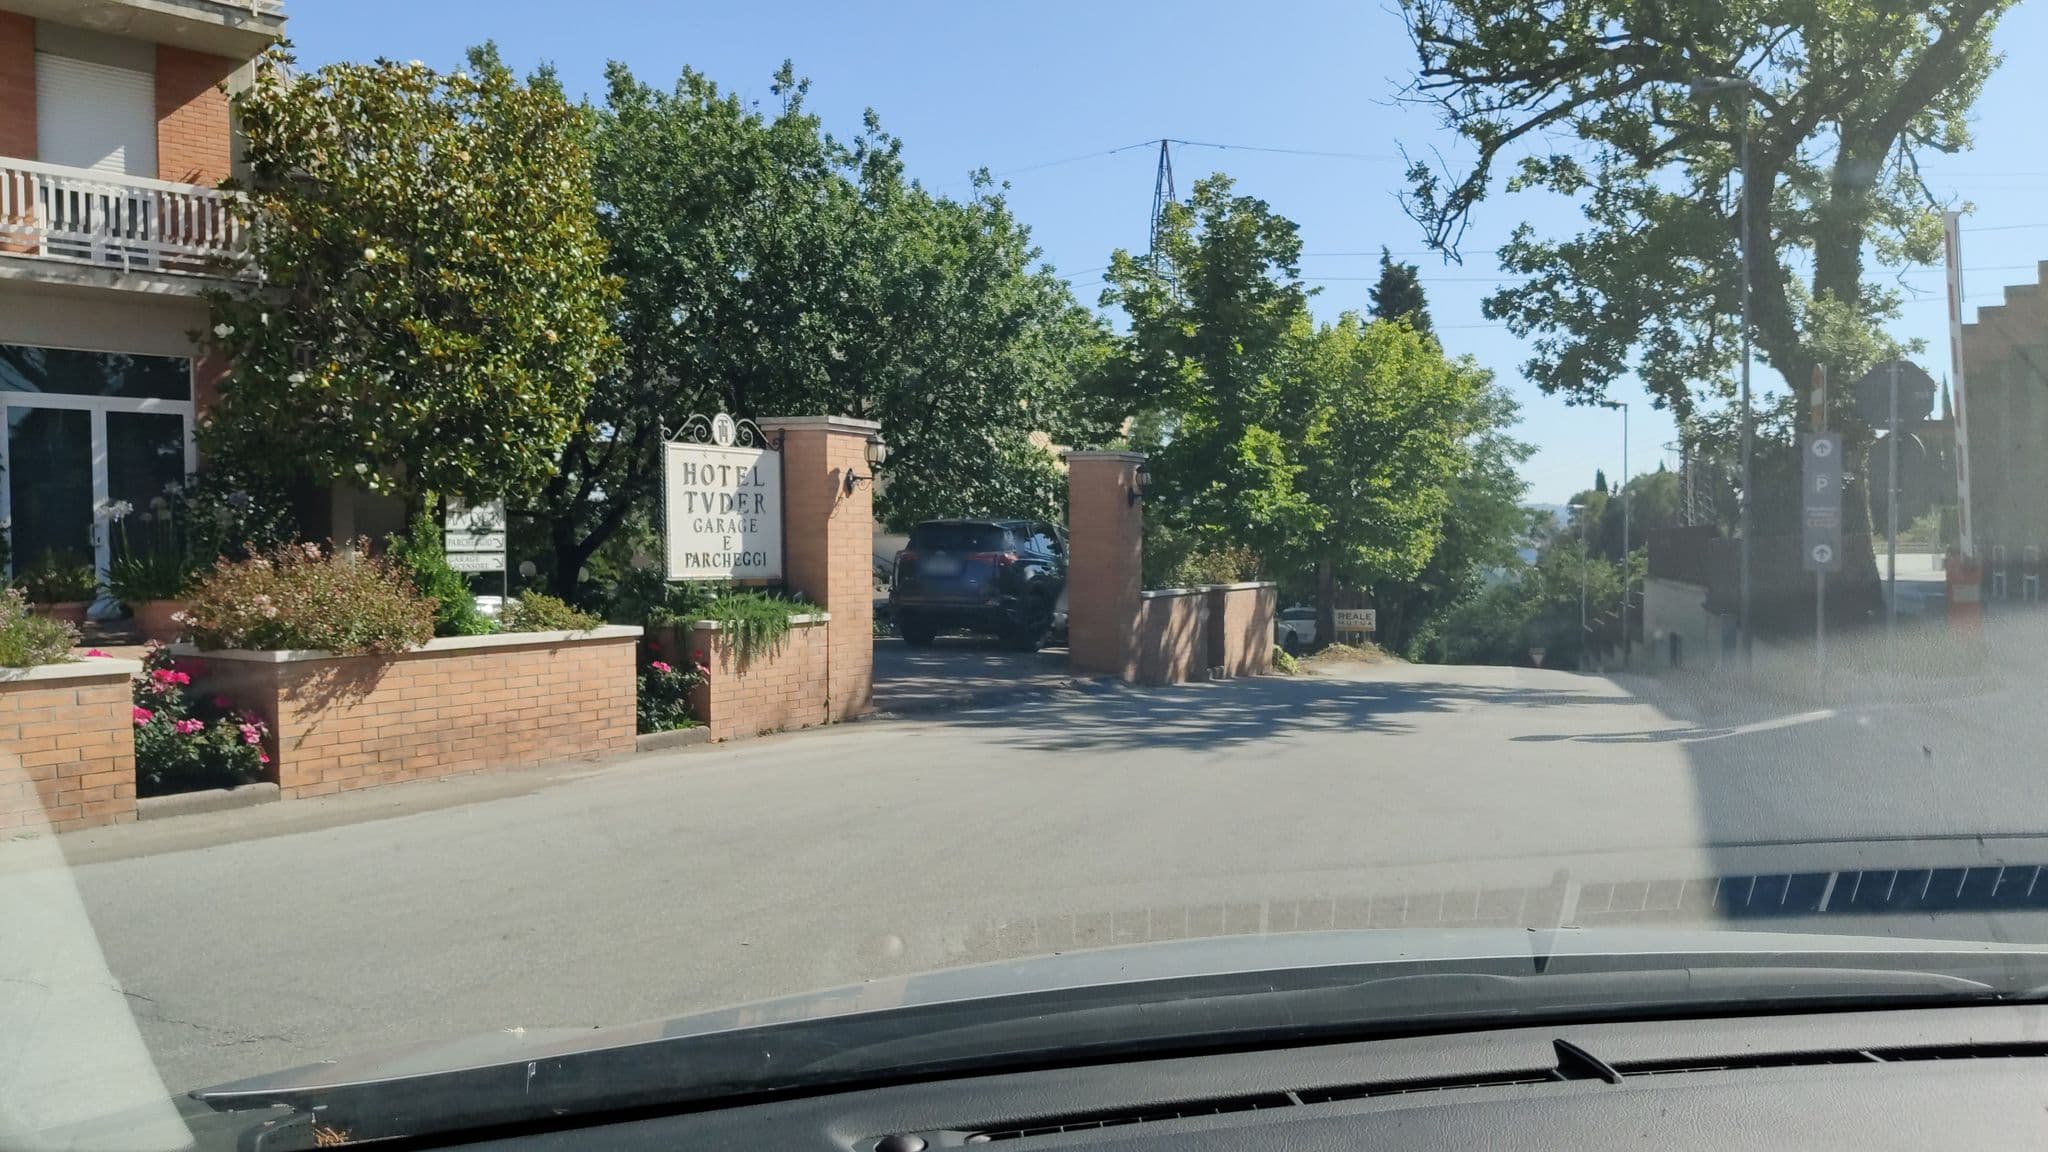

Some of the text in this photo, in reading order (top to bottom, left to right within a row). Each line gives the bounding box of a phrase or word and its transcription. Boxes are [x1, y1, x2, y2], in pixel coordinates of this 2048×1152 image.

[683, 463, 765, 487] HOTEL
[683, 491, 766, 515] TVDER
[693, 518, 758, 533] GARAGE
[723, 535, 732, 551] E
[685, 551, 767, 568] PARCHEGGI
[1337, 612, 1372, 620] REALE
